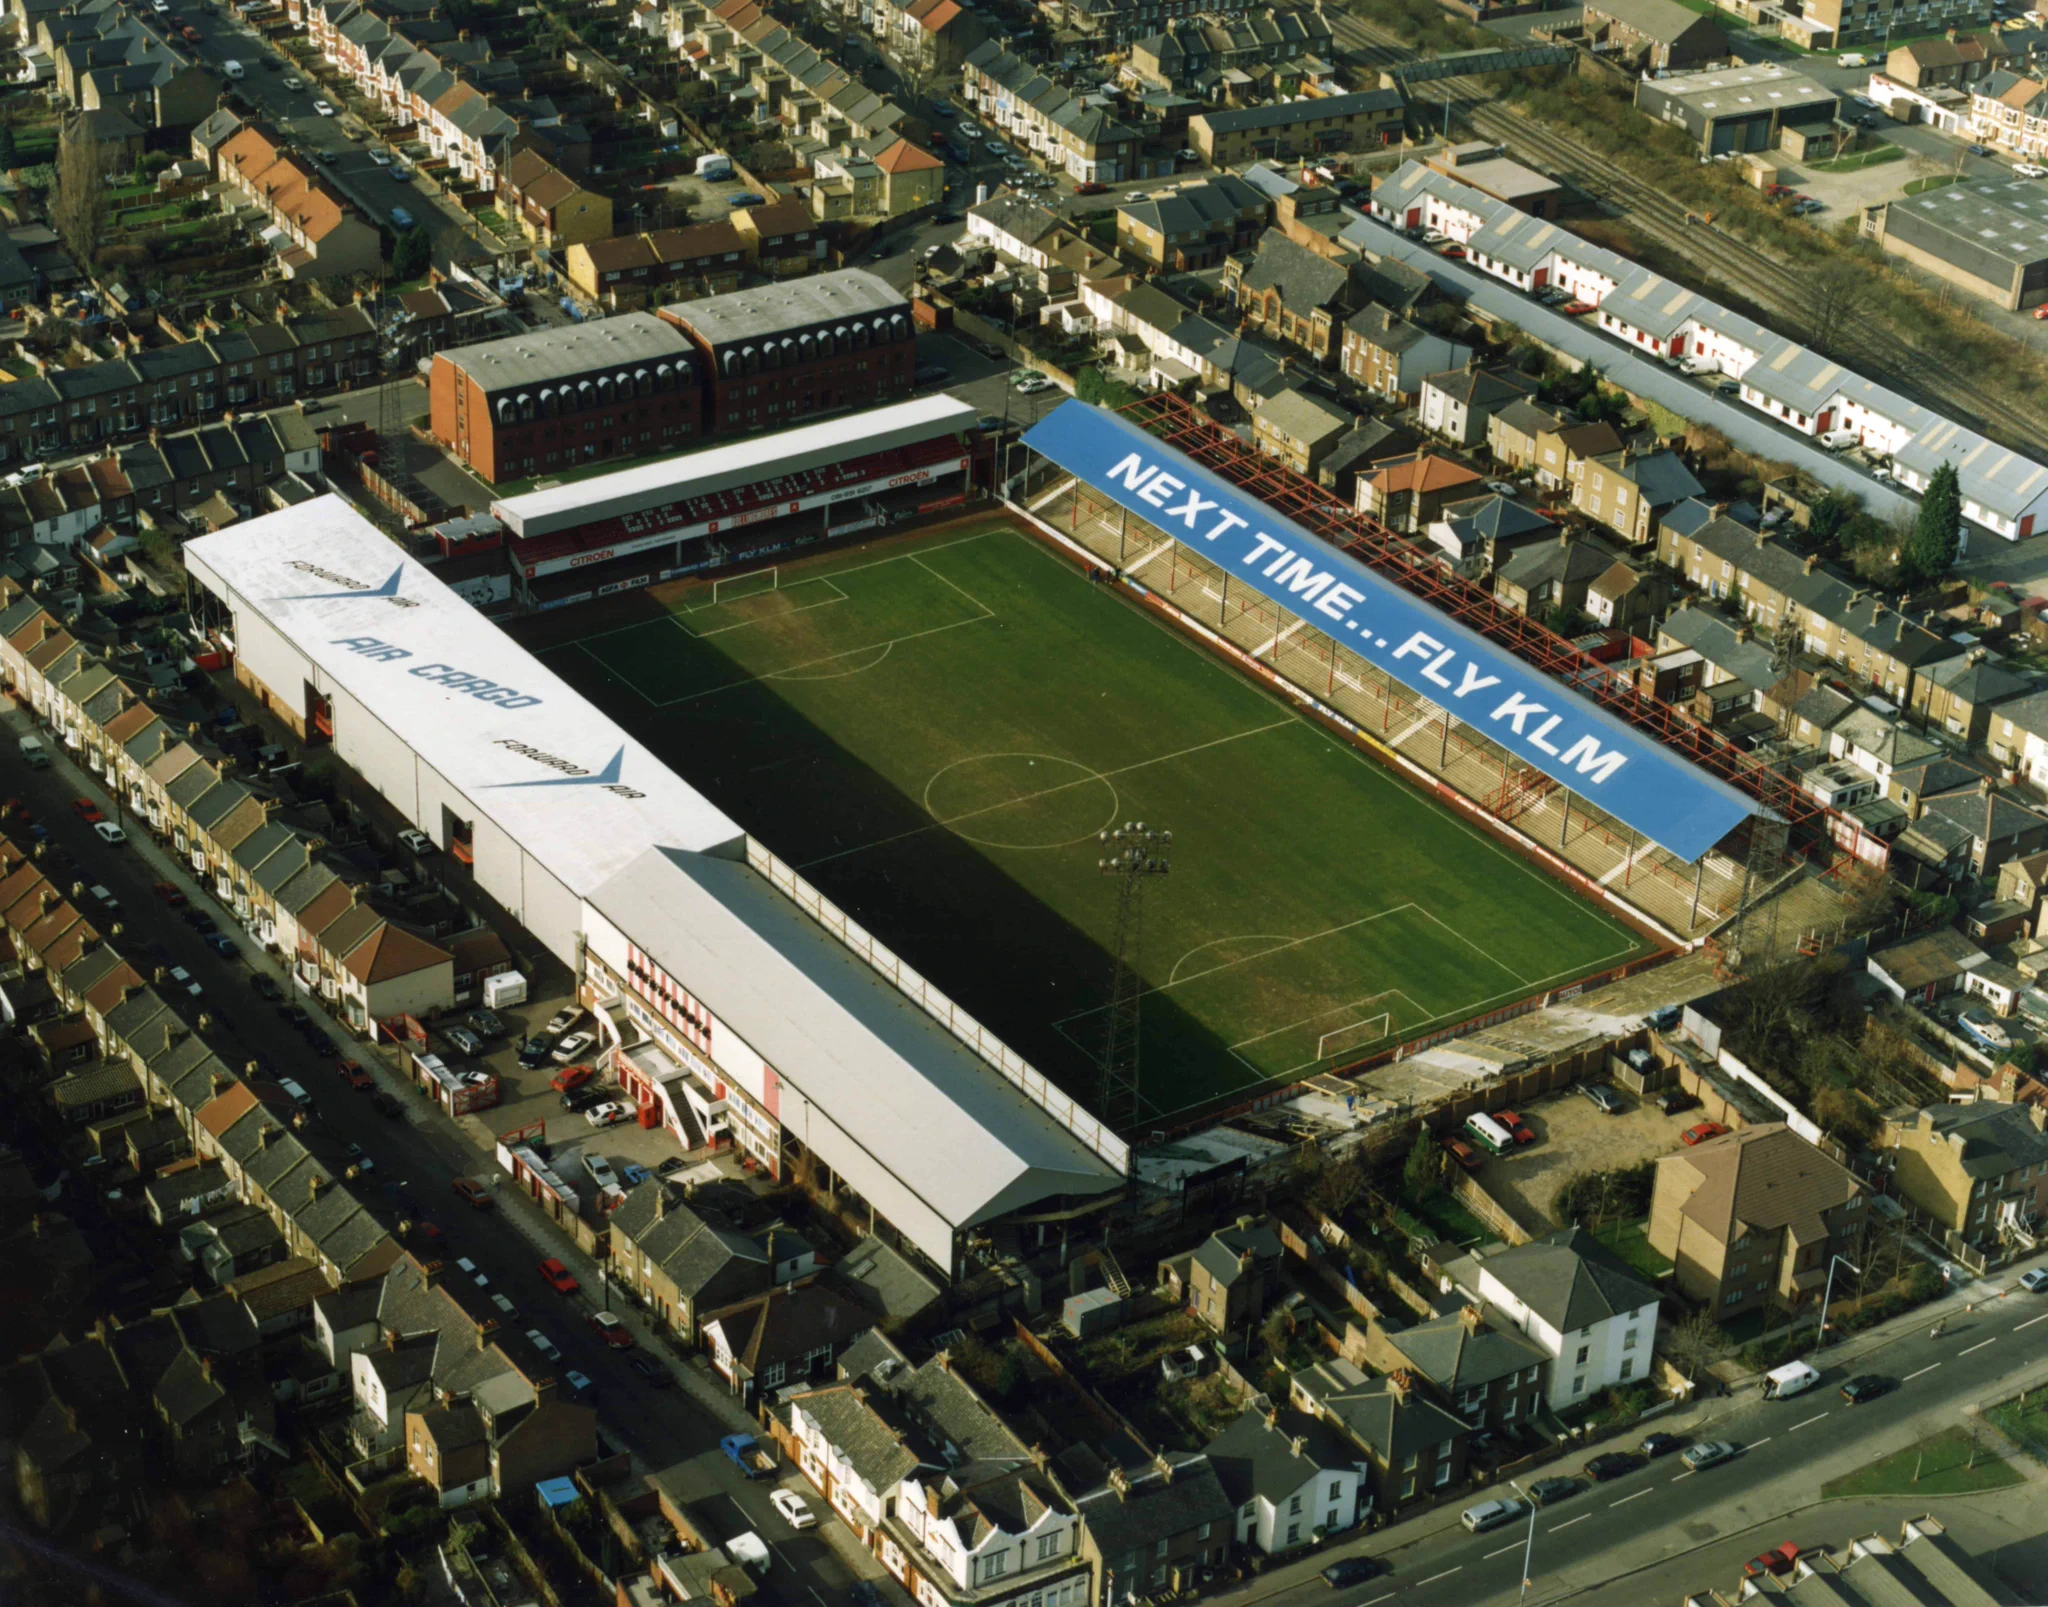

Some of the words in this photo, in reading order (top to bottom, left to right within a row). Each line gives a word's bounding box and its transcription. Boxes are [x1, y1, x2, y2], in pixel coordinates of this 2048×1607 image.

[282, 560, 371, 590] FORWARD
[600, 584, 619, 594] AGFA
[631, 577, 648, 587] FILM
[1106, 452, 1249, 542] NEXT
[1392, 630, 1502, 699] FLY
[1490, 691, 1629, 784] KLM
[329, 636, 413, 662] AIR
[407, 663, 543, 709] CARGO
[492, 739, 590, 776] FORWARD
[601, 784, 647, 799] AIR
